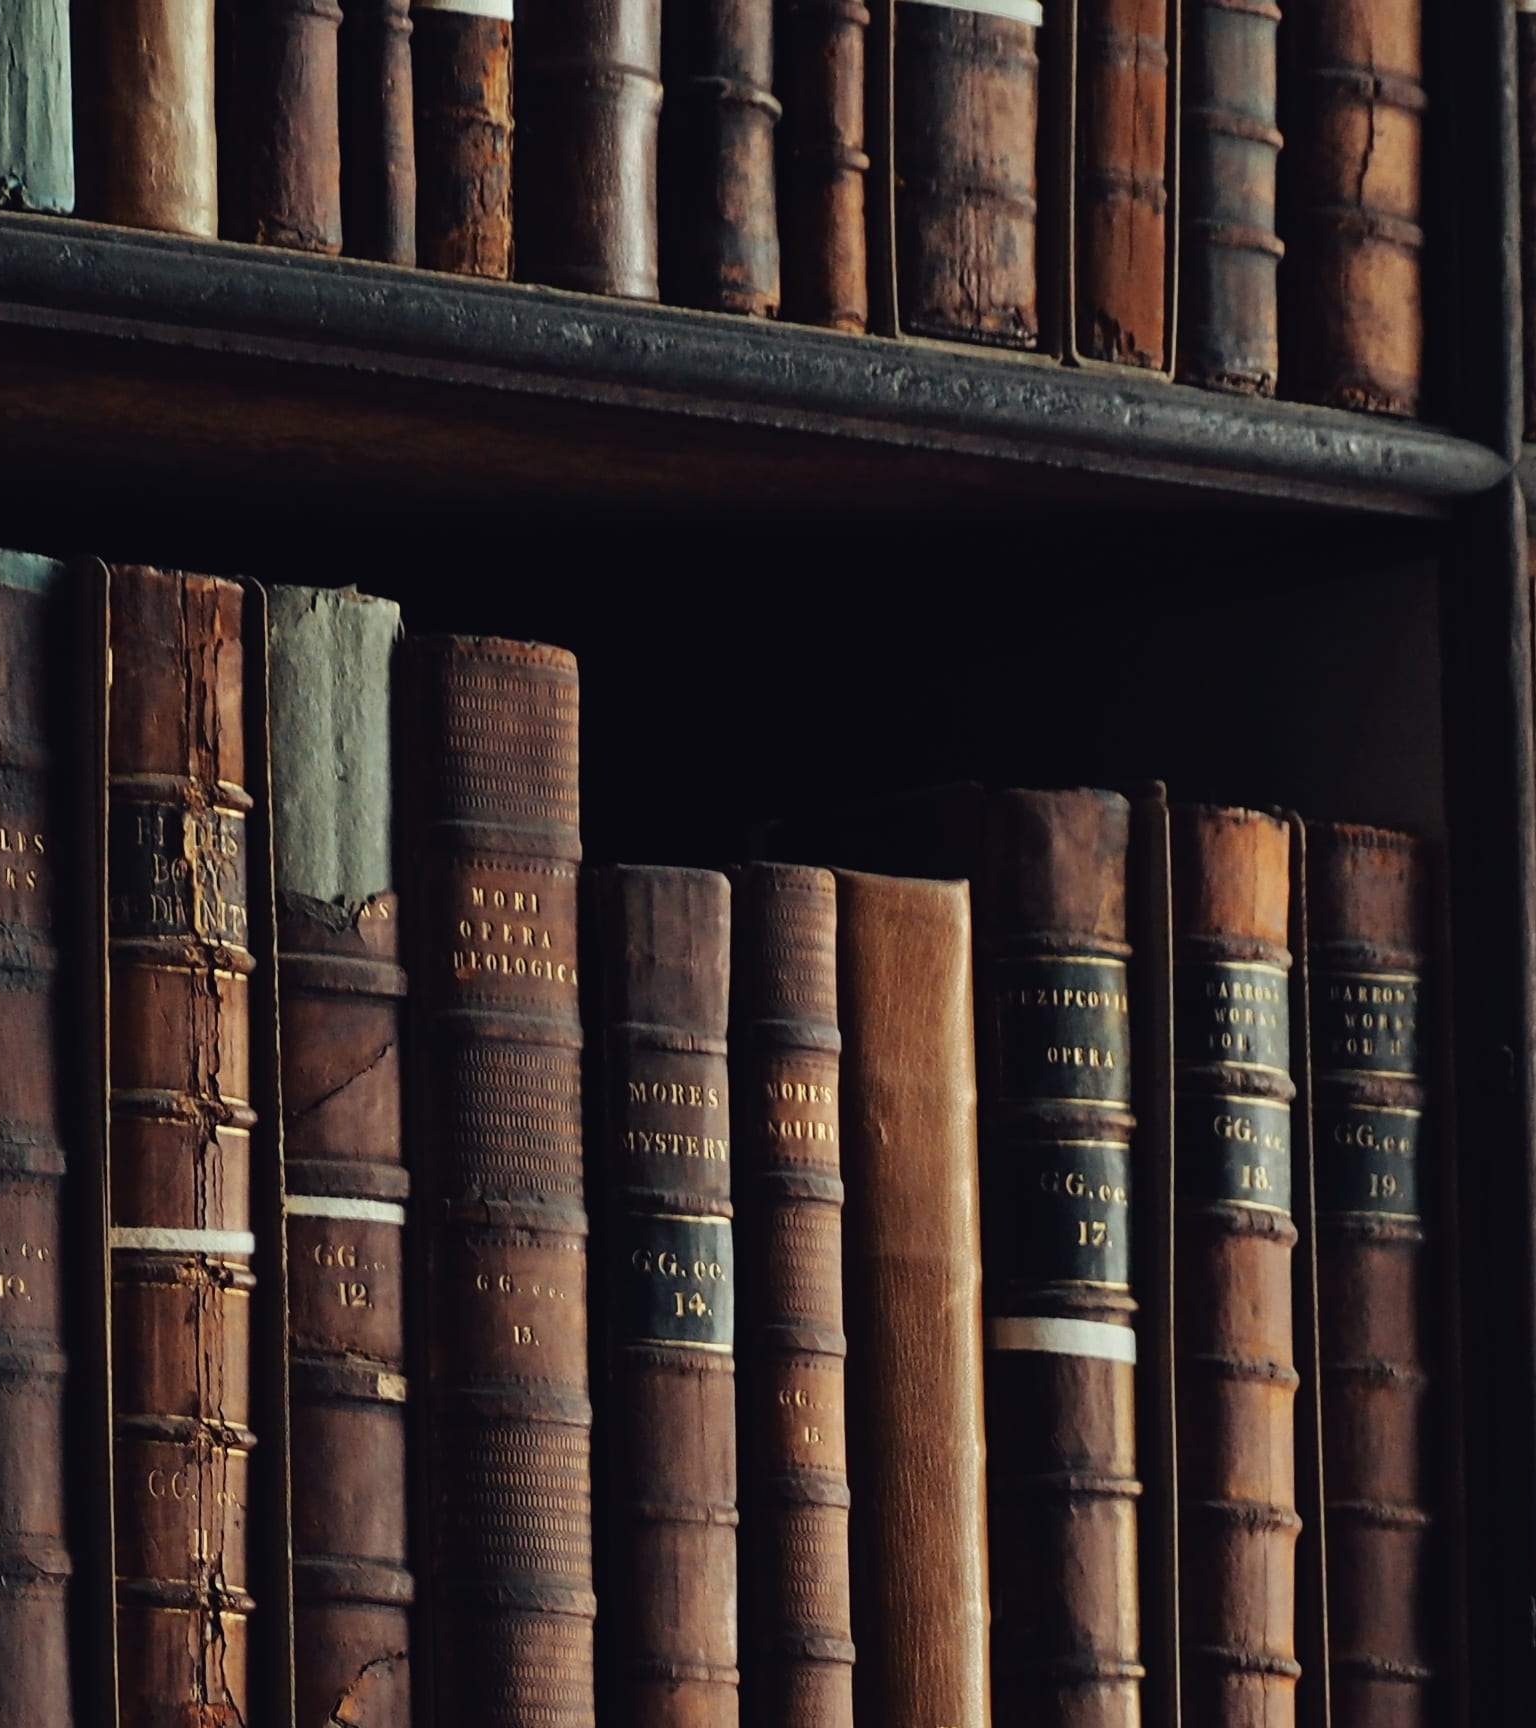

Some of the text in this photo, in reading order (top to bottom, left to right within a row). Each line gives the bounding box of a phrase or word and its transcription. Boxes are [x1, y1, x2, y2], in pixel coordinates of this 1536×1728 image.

[471, 886, 541, 913] MORI
[459, 919, 554, 951] OPERA
[1047, 1046, 1115, 1069] OPERA
[627, 1079, 721, 1109] MORES
[619, 1130, 730, 1162] MYSTERY
[337, 1282, 376, 1310] 12.
[673, 1289, 714, 1318] 14.
